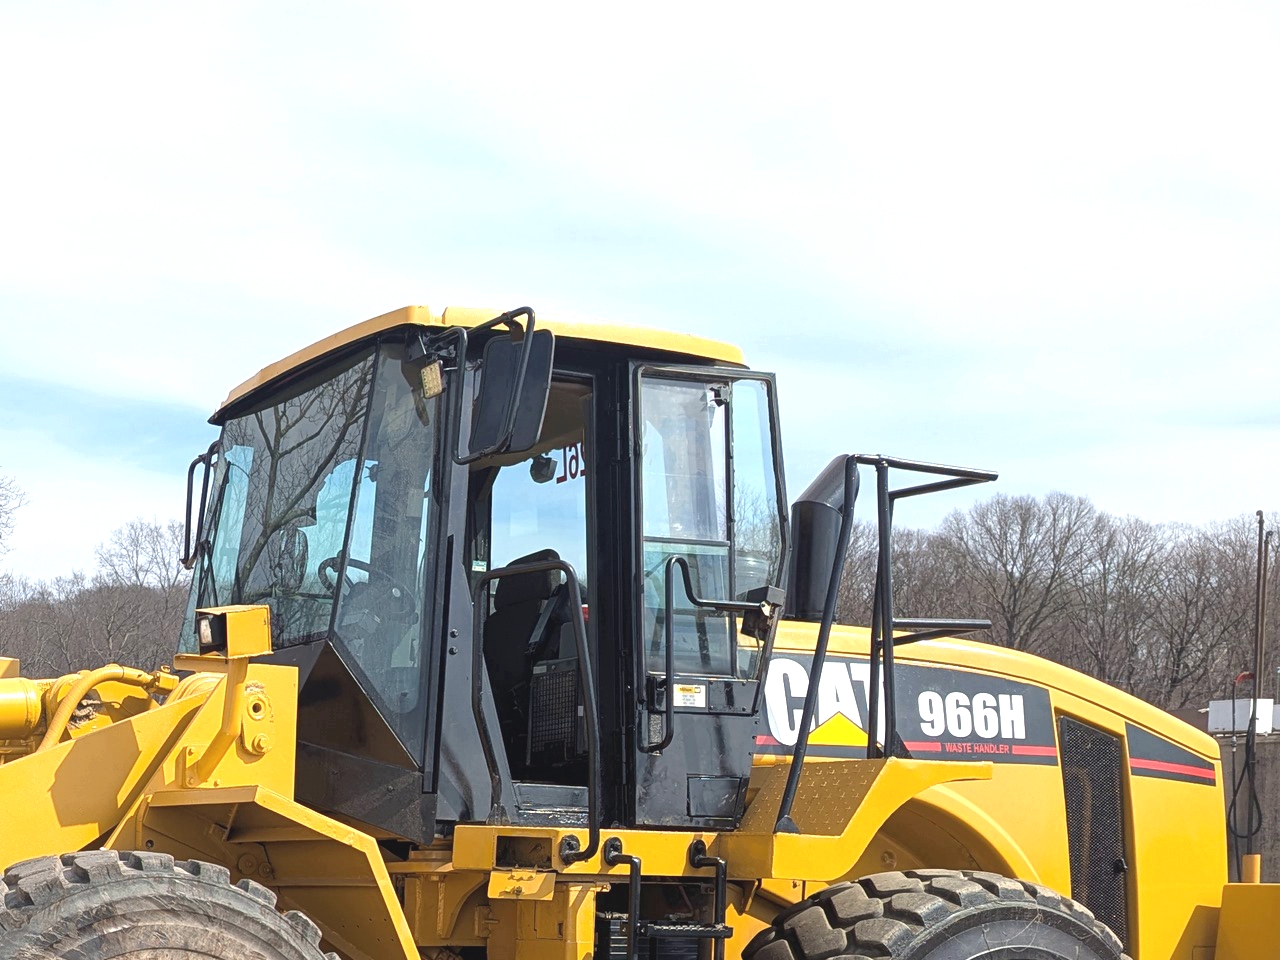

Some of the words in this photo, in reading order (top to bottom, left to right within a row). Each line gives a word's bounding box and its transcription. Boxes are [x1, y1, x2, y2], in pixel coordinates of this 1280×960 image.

[764, 658, 886, 747] CAT
[917, 691, 1026, 740] 966H
[945, 742, 972, 753] WASTE
[973, 743, 1010, 754] HANDLER
